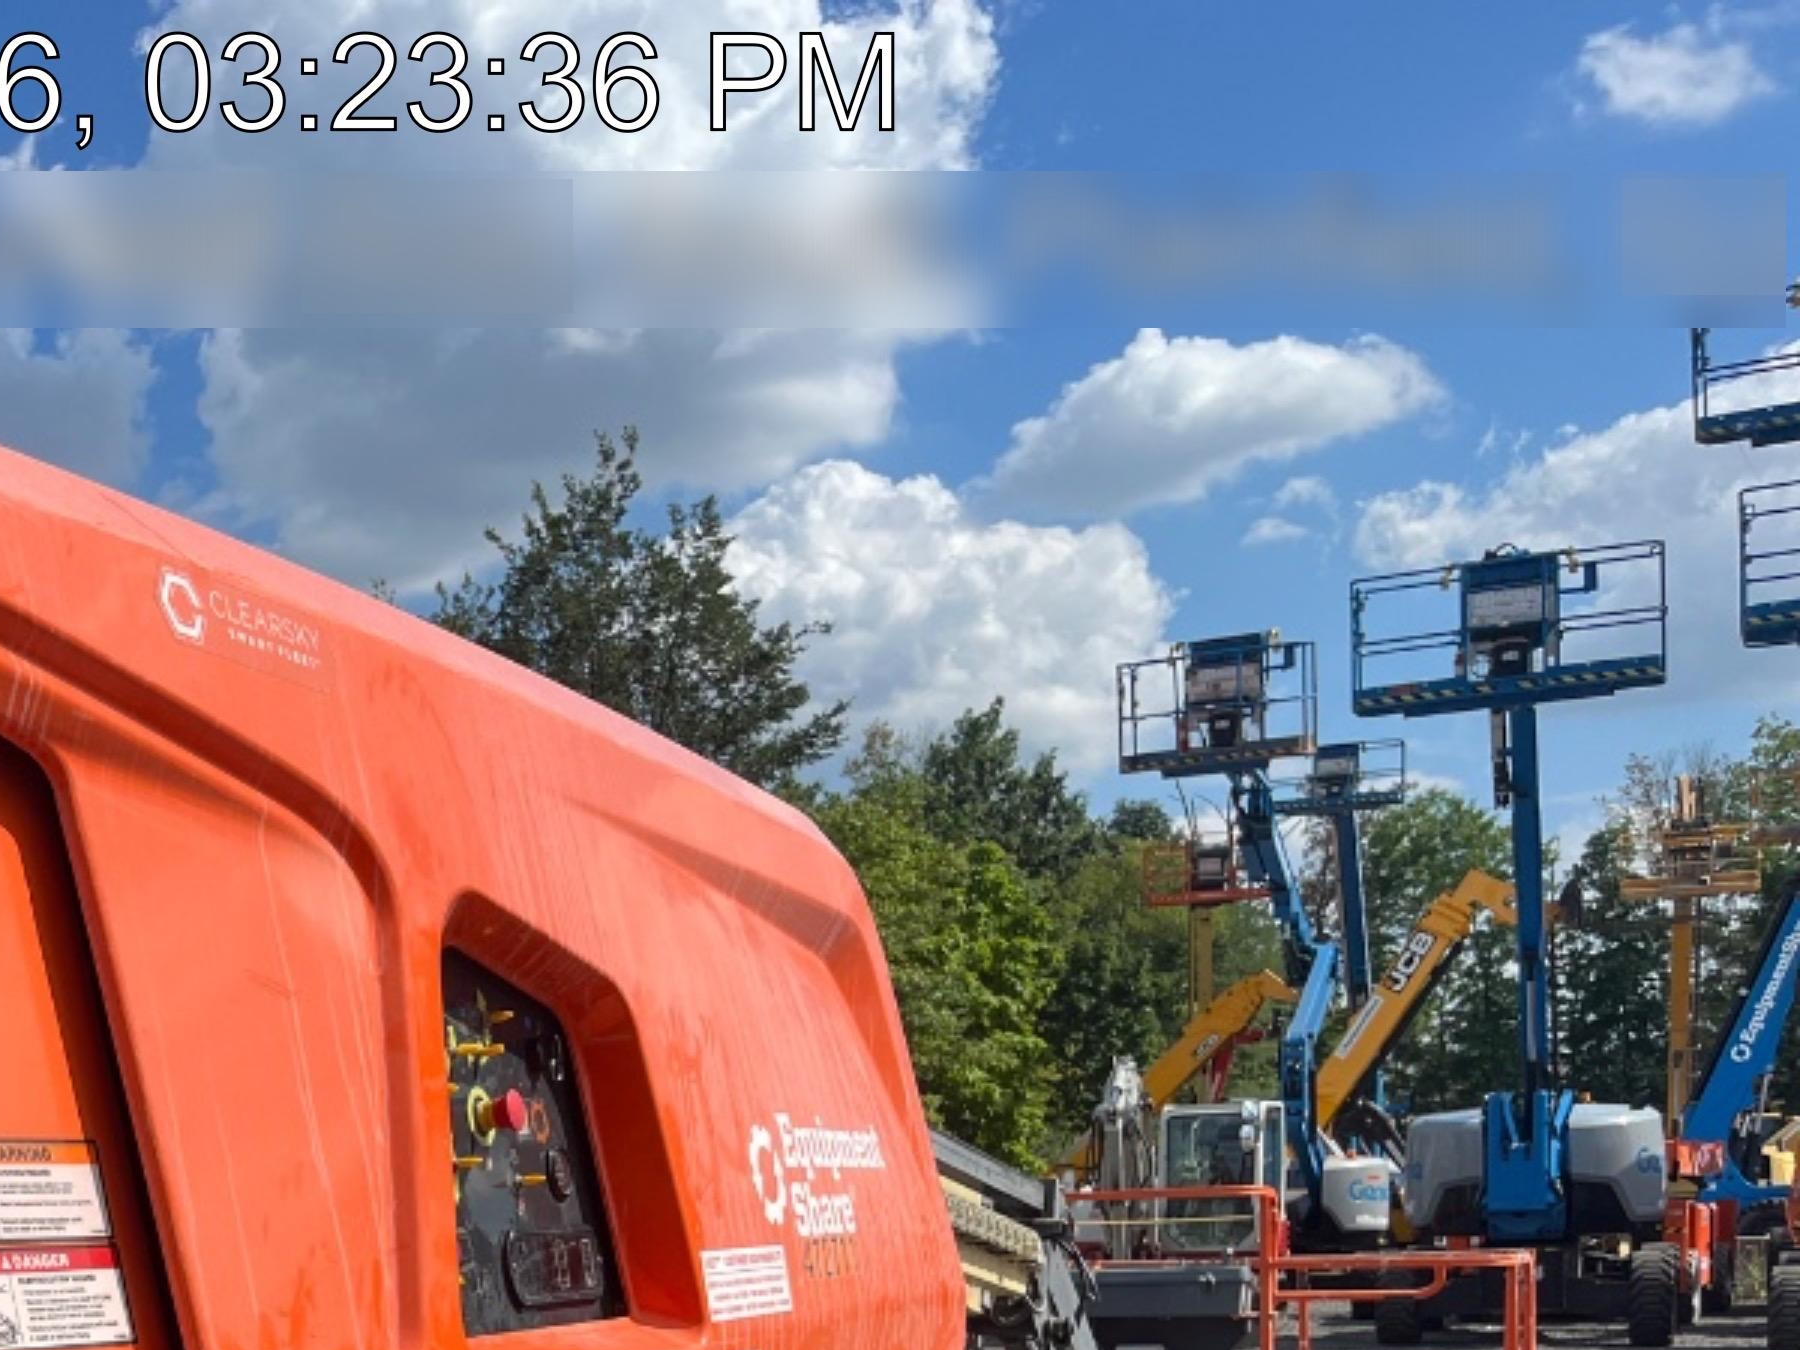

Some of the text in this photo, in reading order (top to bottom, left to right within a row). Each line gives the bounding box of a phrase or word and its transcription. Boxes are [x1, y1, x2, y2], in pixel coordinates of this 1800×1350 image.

[208, 589, 320, 652] CLEARSKY
[1389, 930, 1435, 992] JCB
[773, 1111, 887, 1182] Equipment
[791, 1181, 857, 1237] Share
